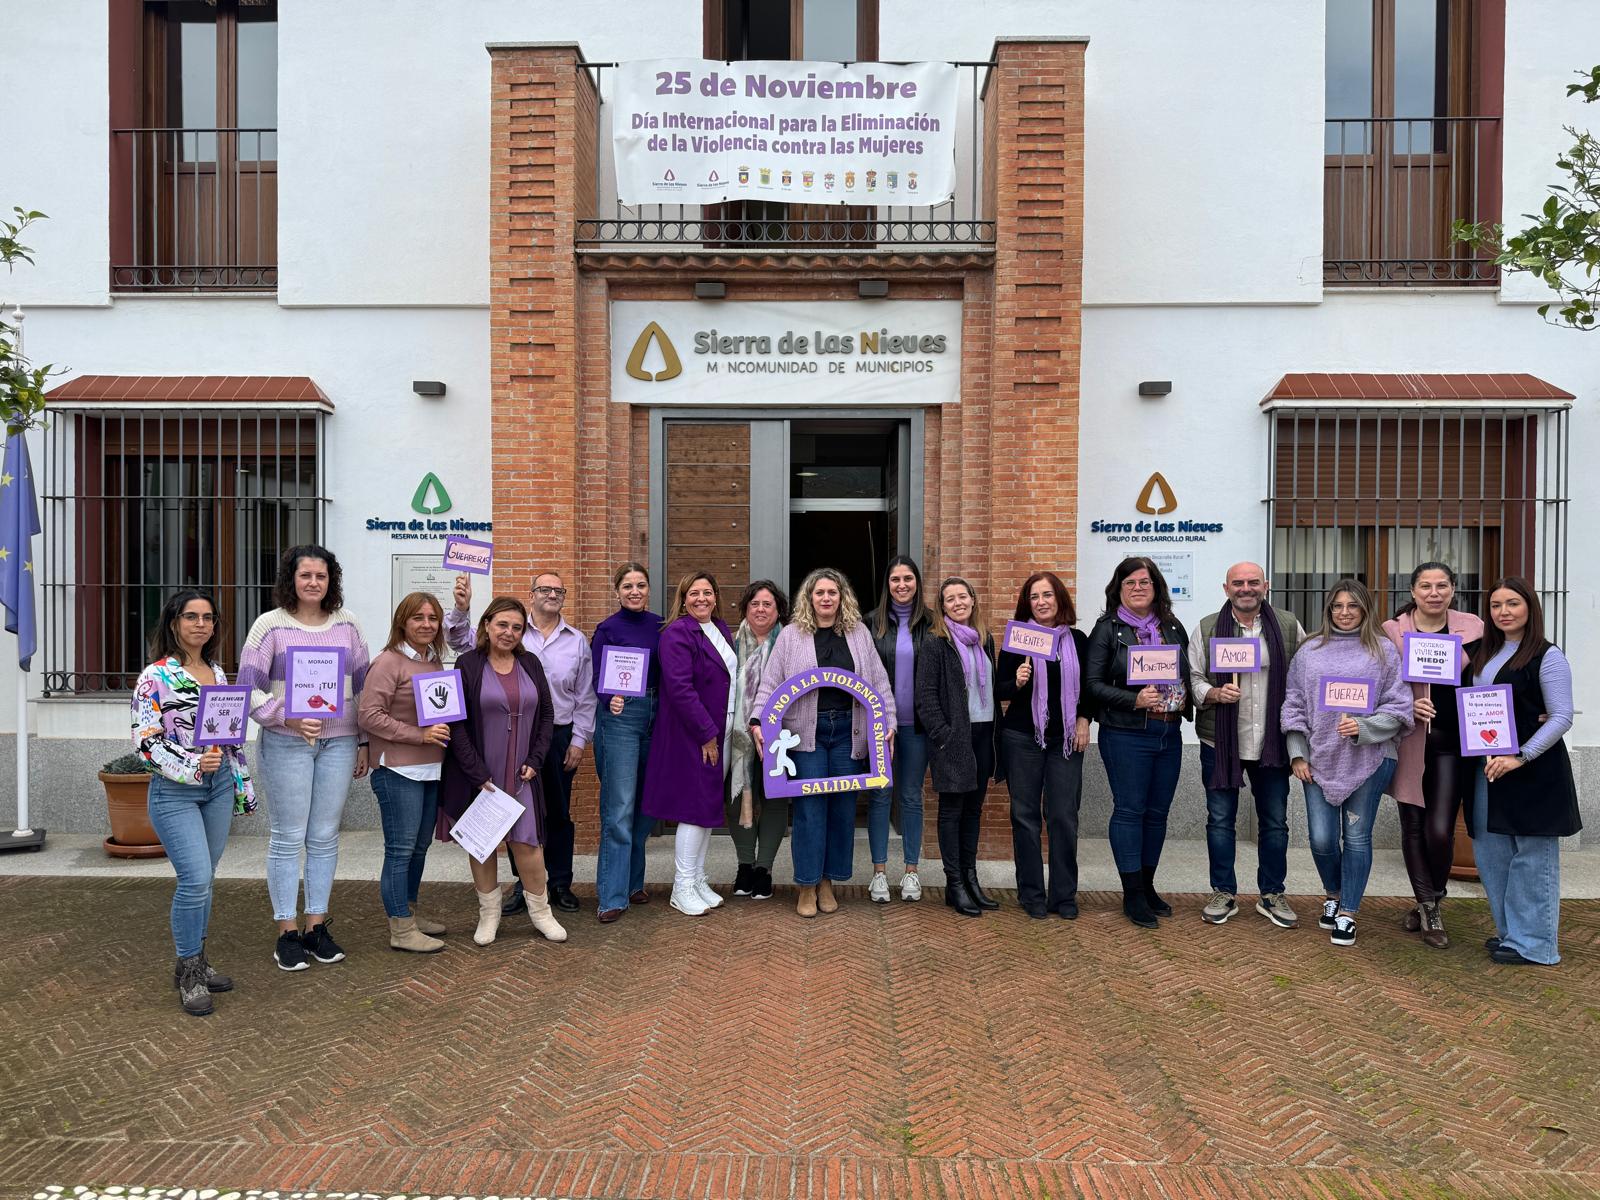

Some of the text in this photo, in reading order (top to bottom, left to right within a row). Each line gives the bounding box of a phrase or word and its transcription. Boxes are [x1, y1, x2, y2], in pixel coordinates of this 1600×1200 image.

[656, 72, 917, 99] 25 de Noviembre
[632, 110, 940, 135] Día Internacional para la Eliminación
[648, 134, 923, 157] de la Violencia contra las Mujeres
[694, 328, 946, 355] Sierra de las Nieves
[829, 362, 845, 374] DE
[856, 360, 934, 374] MUNICIPIOS
[366, 517, 492, 531] Sierra de las Nieves
[1091, 520, 1223, 533] Sierra de las Nieves
[773, 694, 790, 712] NO
[790, 685, 800, 695] A
[800, 674, 819, 689] LA
[822, 672, 883, 719] VIOLENCIA
[802, 778, 861, 794] SALIDA
